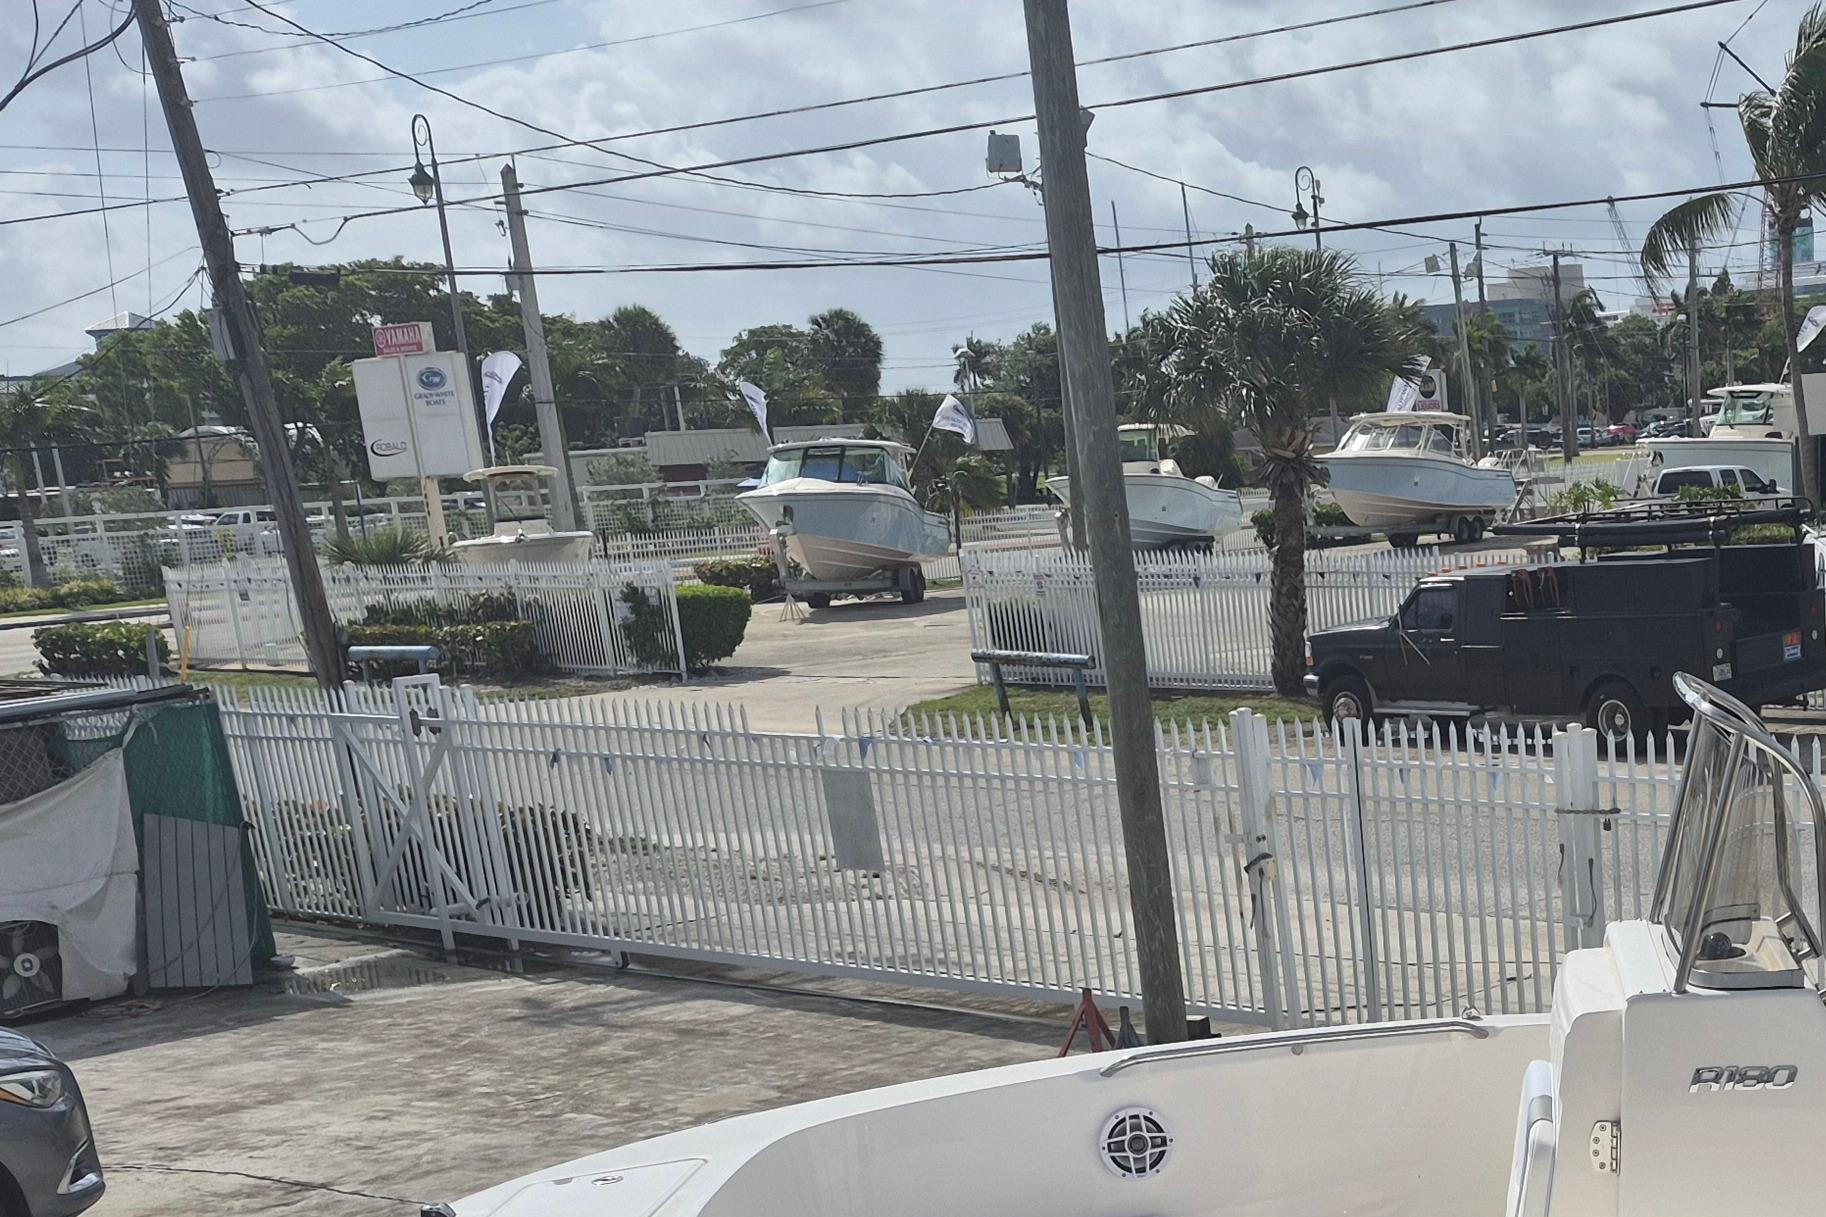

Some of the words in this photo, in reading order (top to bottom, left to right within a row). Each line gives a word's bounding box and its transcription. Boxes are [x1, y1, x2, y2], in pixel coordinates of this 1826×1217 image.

[385, 325, 422, 345] YAMAHA
[375, 440, 408, 452] ROBALO
[1688, 1064, 1799, 1094] R180
